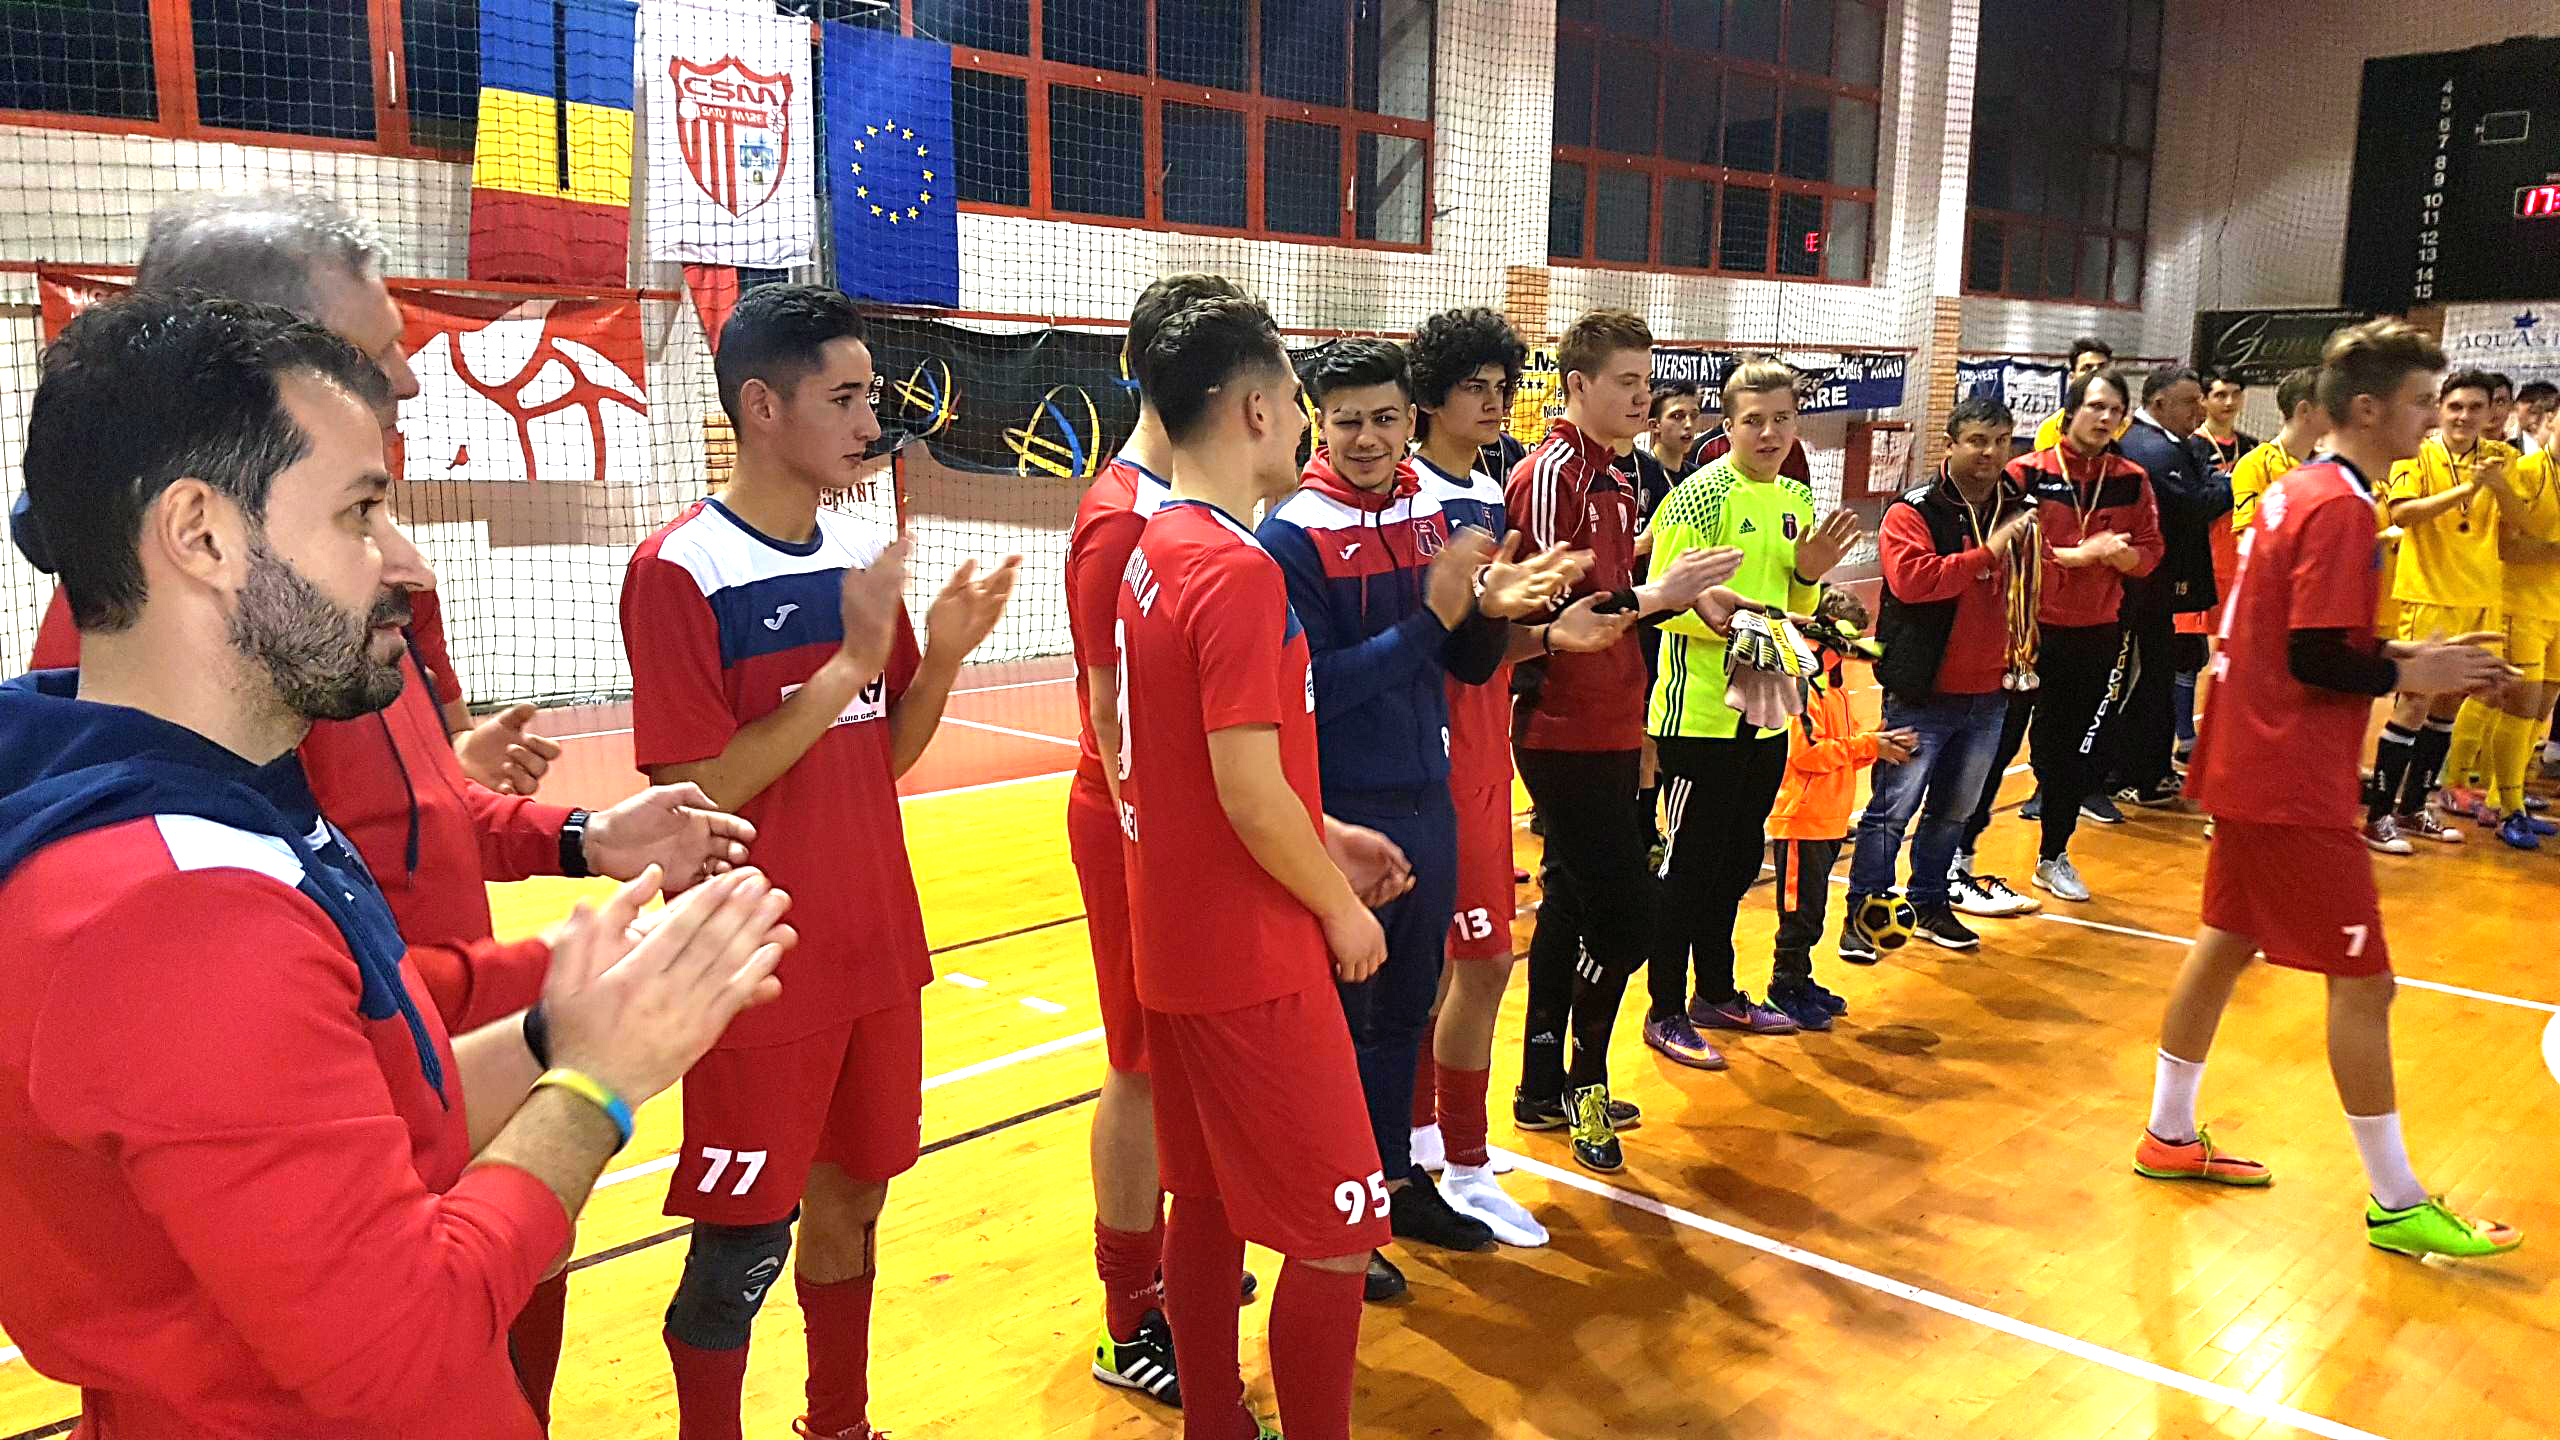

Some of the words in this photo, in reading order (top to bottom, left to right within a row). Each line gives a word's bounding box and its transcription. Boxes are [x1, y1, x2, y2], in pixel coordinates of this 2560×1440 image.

[684, 77, 779, 106] CSM
[2442, 79, 2453, 93] 4
[2439, 117, 2450, 131] 6
[2439, 134, 2449, 149] 7
[2435, 155, 2447, 170] 8
[2433, 172, 2445, 186] 9
[2423, 192, 2443, 208] 10
[2422, 211, 2440, 225] 11
[2420, 231, 2438, 246] 12
[2418, 247, 2437, 263] 13
[2416, 267, 2434, 282] 14
[2414, 284, 2433, 298] 15
[1453, 907, 1492, 941] 13
[2341, 924, 2368, 957] 7
[697, 1146, 767, 1196] 77
[1334, 1169, 1391, 1225] 95
